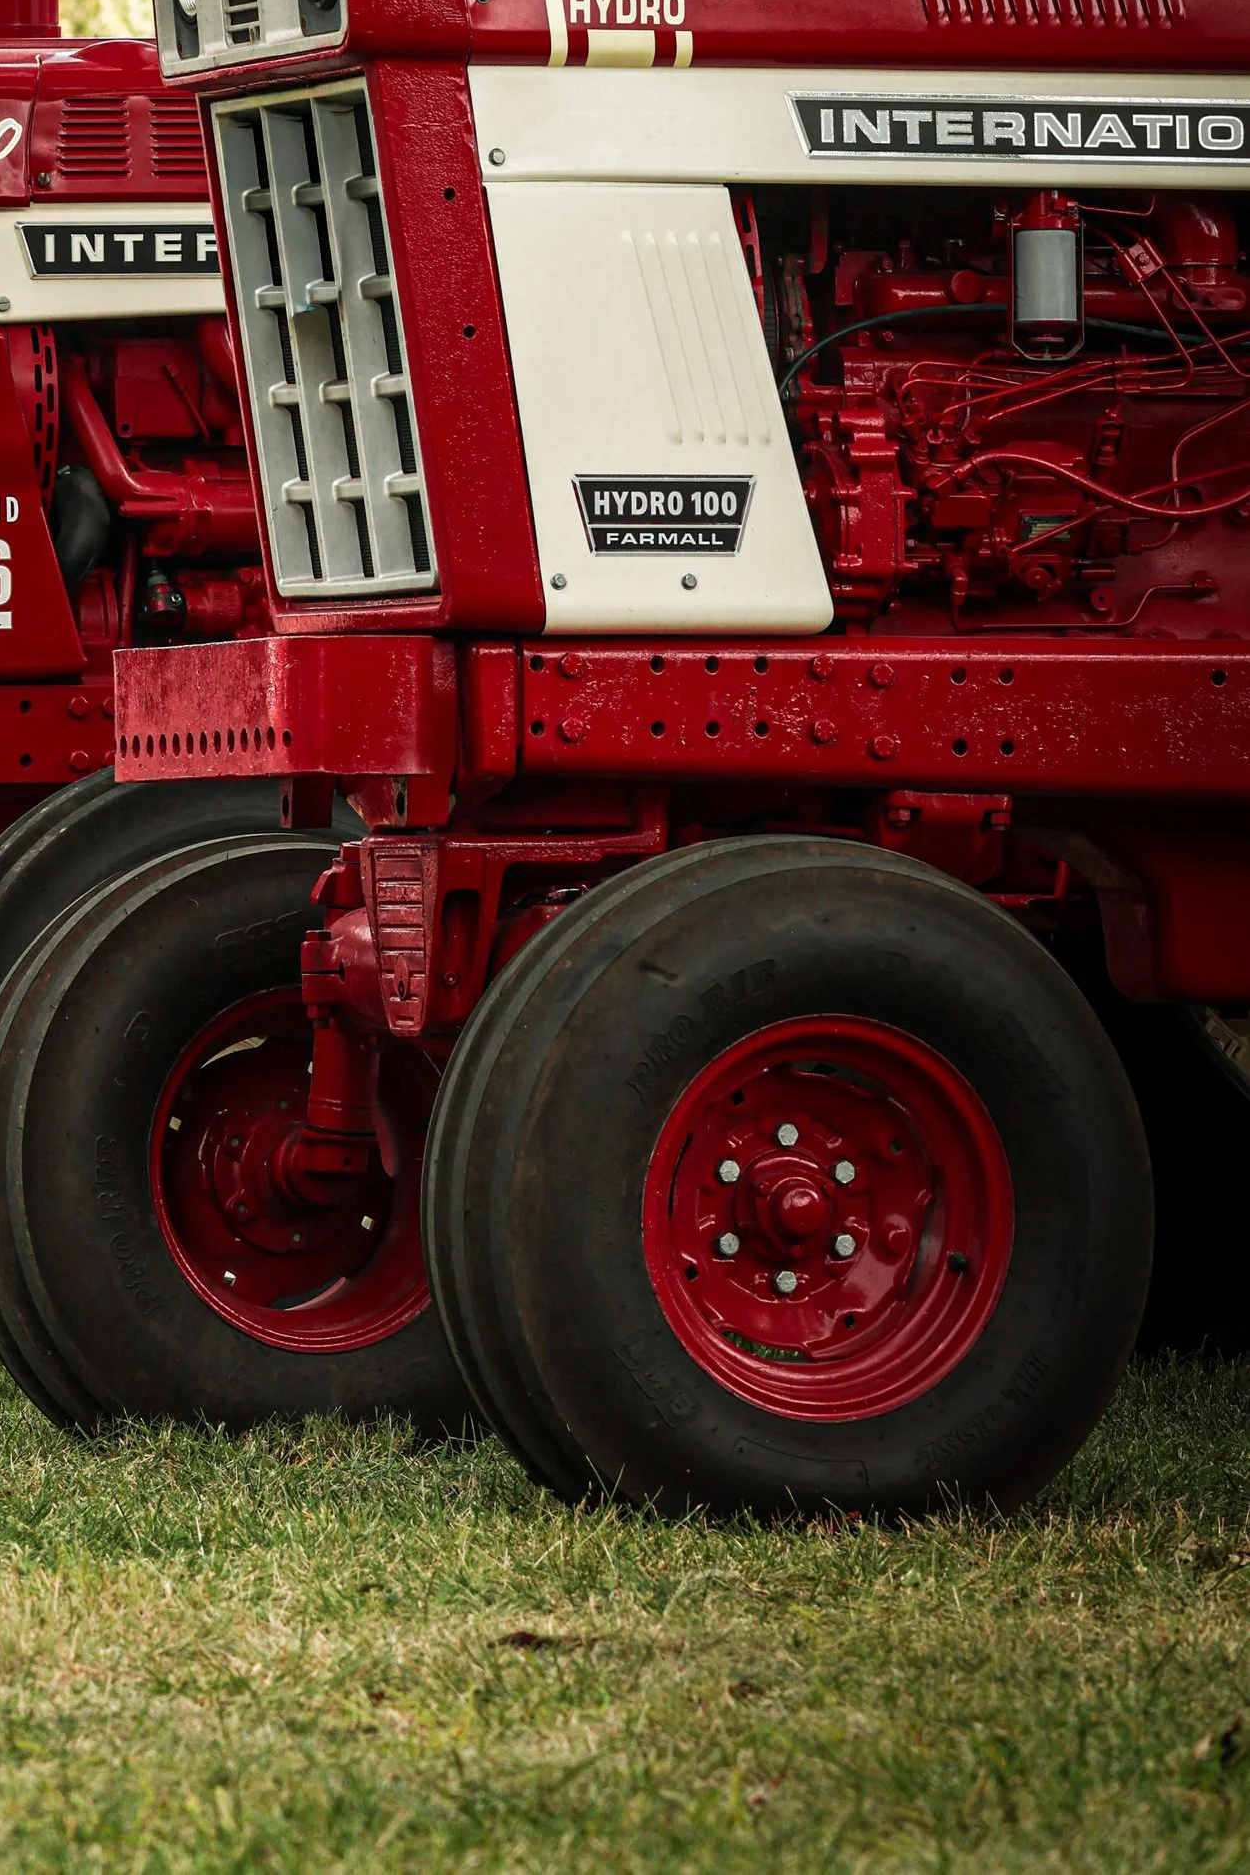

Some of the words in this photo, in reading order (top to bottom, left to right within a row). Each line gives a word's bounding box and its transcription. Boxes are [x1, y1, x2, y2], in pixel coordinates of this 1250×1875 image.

[820, 108, 1245, 151] INTERNATIO
[594, 490, 684, 516] HYDRO
[691, 490, 737, 517] 100
[606, 532, 724, 546] FARMALL
